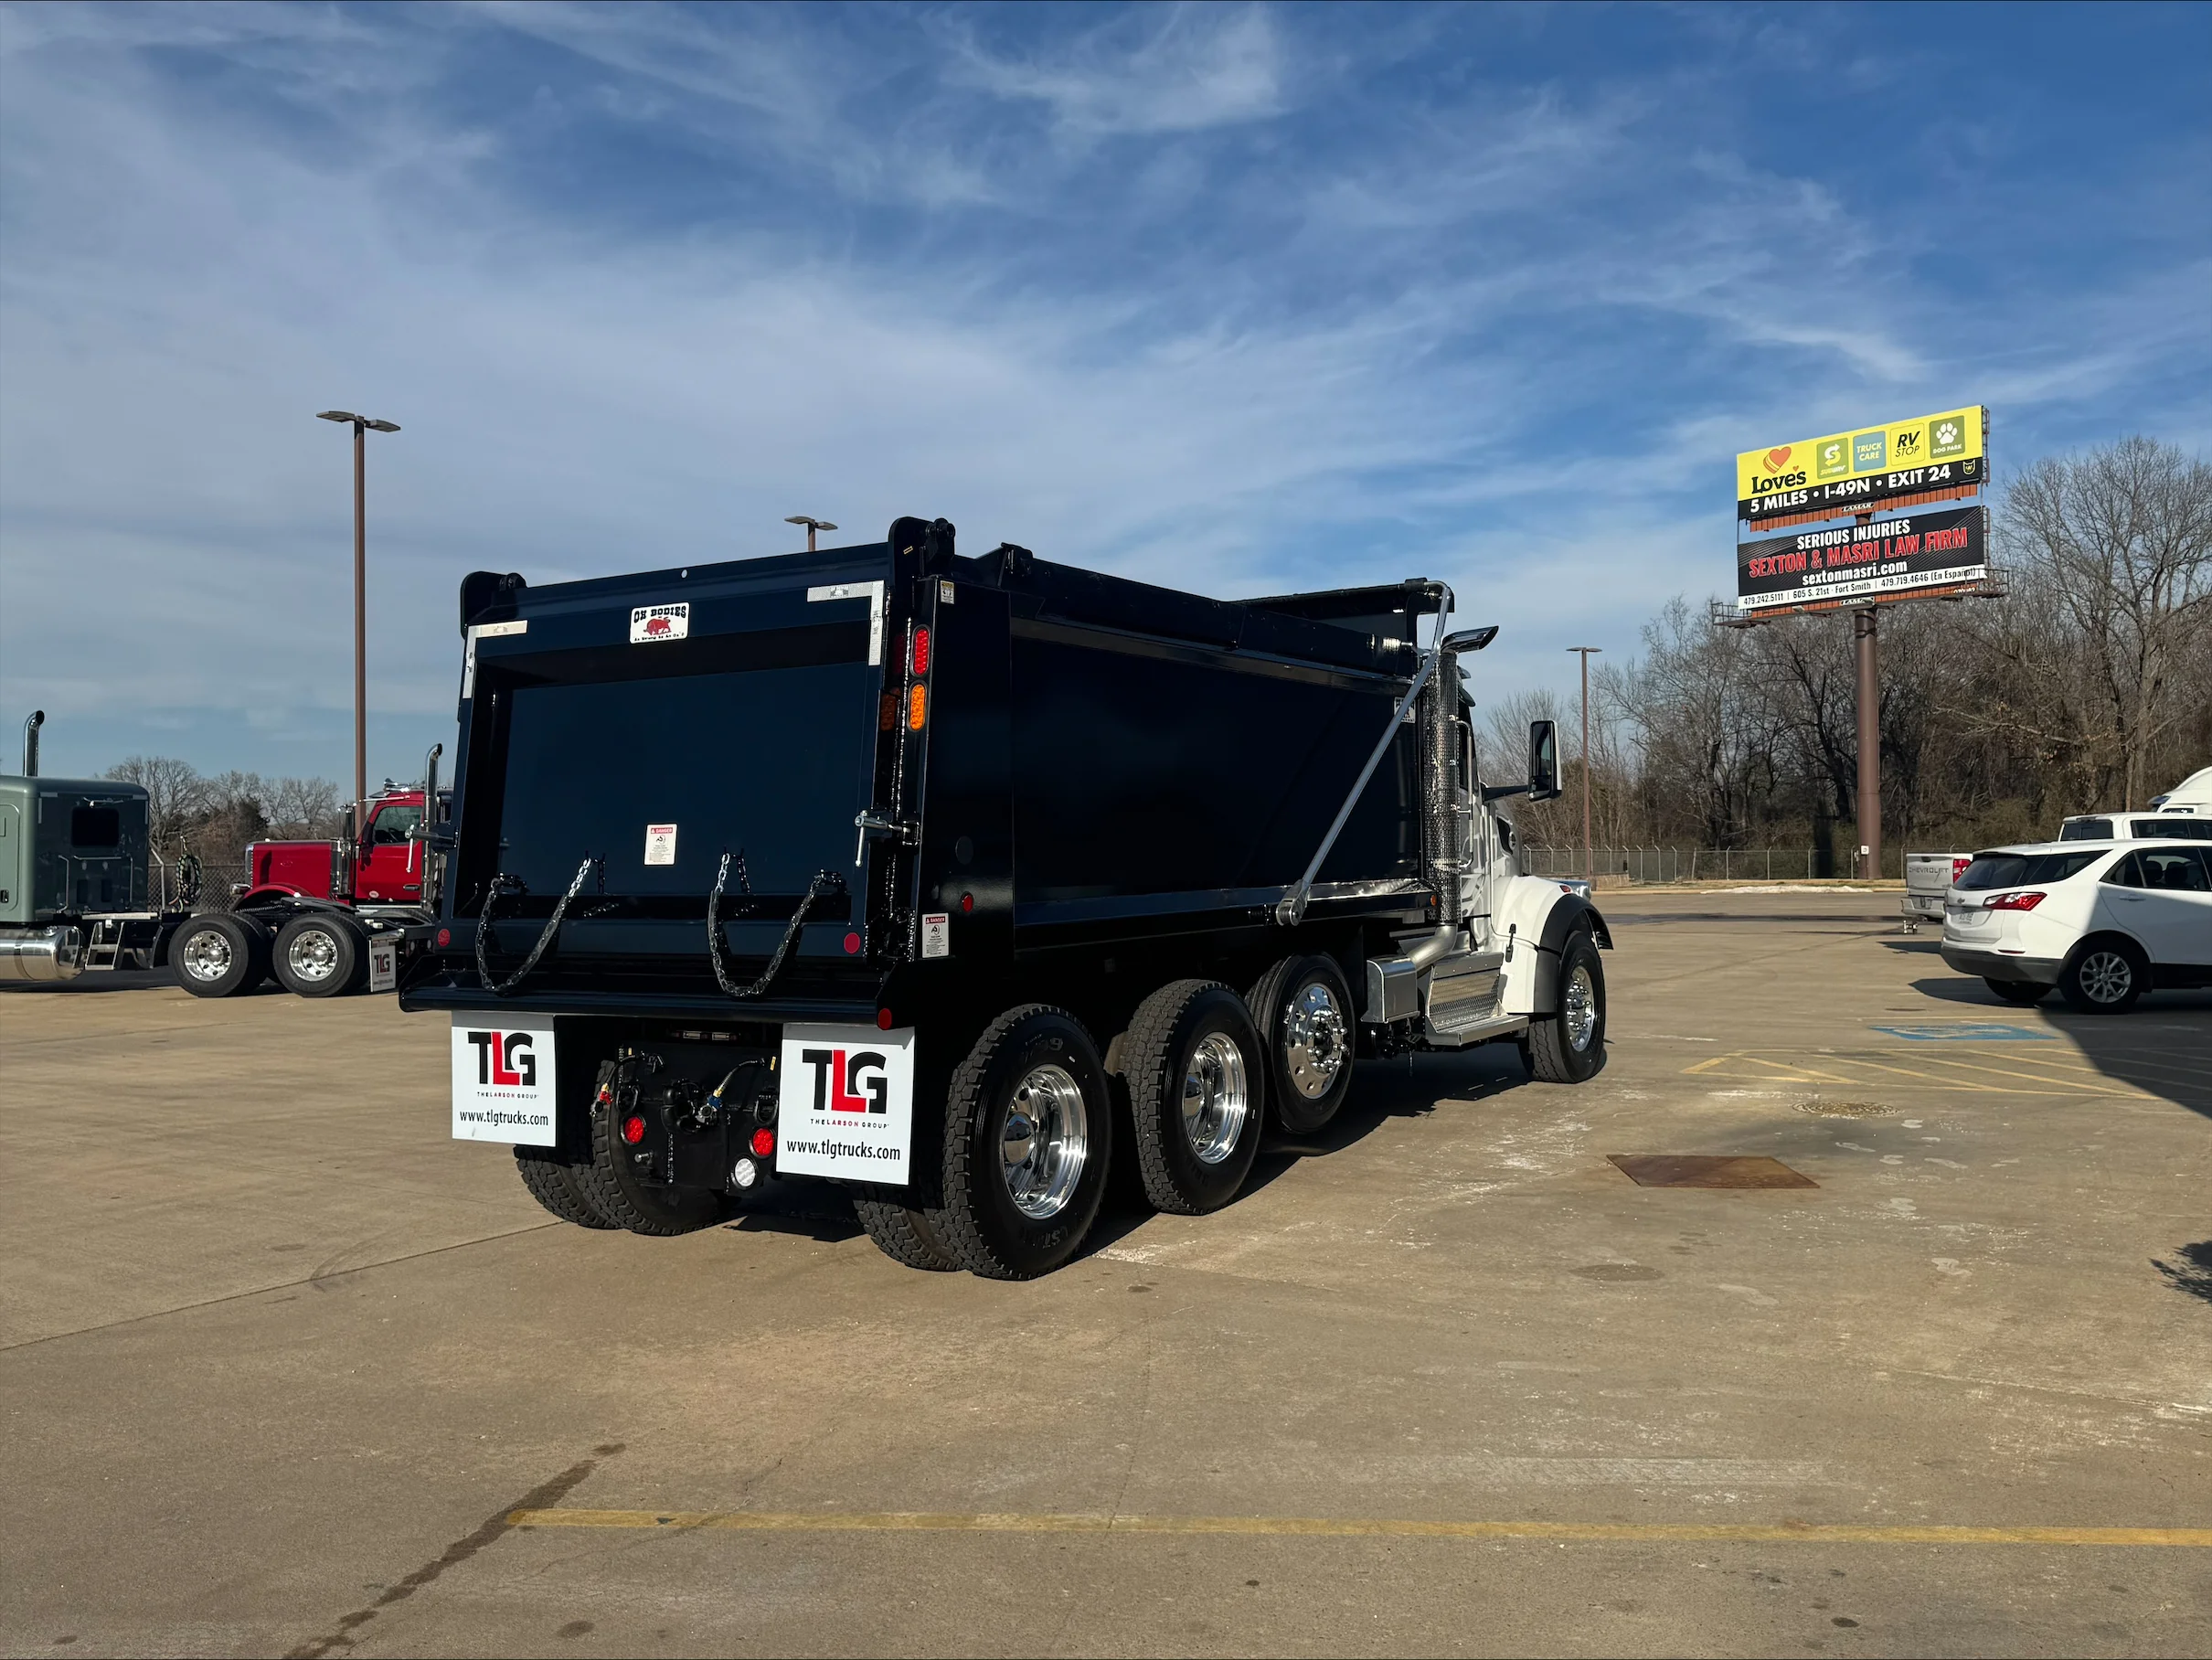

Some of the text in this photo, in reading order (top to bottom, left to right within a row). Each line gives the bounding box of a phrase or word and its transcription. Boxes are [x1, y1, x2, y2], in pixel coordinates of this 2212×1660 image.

[1856, 442, 1882, 453] TRUCK
[1897, 431, 1920, 448] RV
[1947, 443, 1962, 452] PARK
[1859, 451, 1880, 462] CARE
[1895, 445, 1920, 458] STOP
[1750, 499, 1760, 513] 5
[1763, 489, 1808, 511] MILES
[1824, 478, 1871, 499] I-49N
[1888, 469, 1924, 489] EXIT
[1928, 464, 1951, 482] 24
[1843, 503, 1872, 512] LAMAR
[1797, 519, 1910, 550] SERIOUS INJURIES
[1749, 527, 1967, 578] SEXTON & MASRI LAW FIRM
[1802, 561, 1908, 586] sextonmasri.com
[1744, 593, 1784, 606] 479.242.5111
[1793, 590, 1806, 599] 605
[1835, 584, 1849, 594] Fort
[1850, 581, 1871, 592] Smith
[1881, 573, 1928, 587] 479.719.4646
[650, 606, 686, 618] BODIES
[468, 1032, 536, 1086] TLG
[803, 1049, 888, 1114] TLG
[459, 1109, 548, 1127] www.tlgtrucks.com
[787, 1139, 900, 1160] www.tlgtrucks.com
